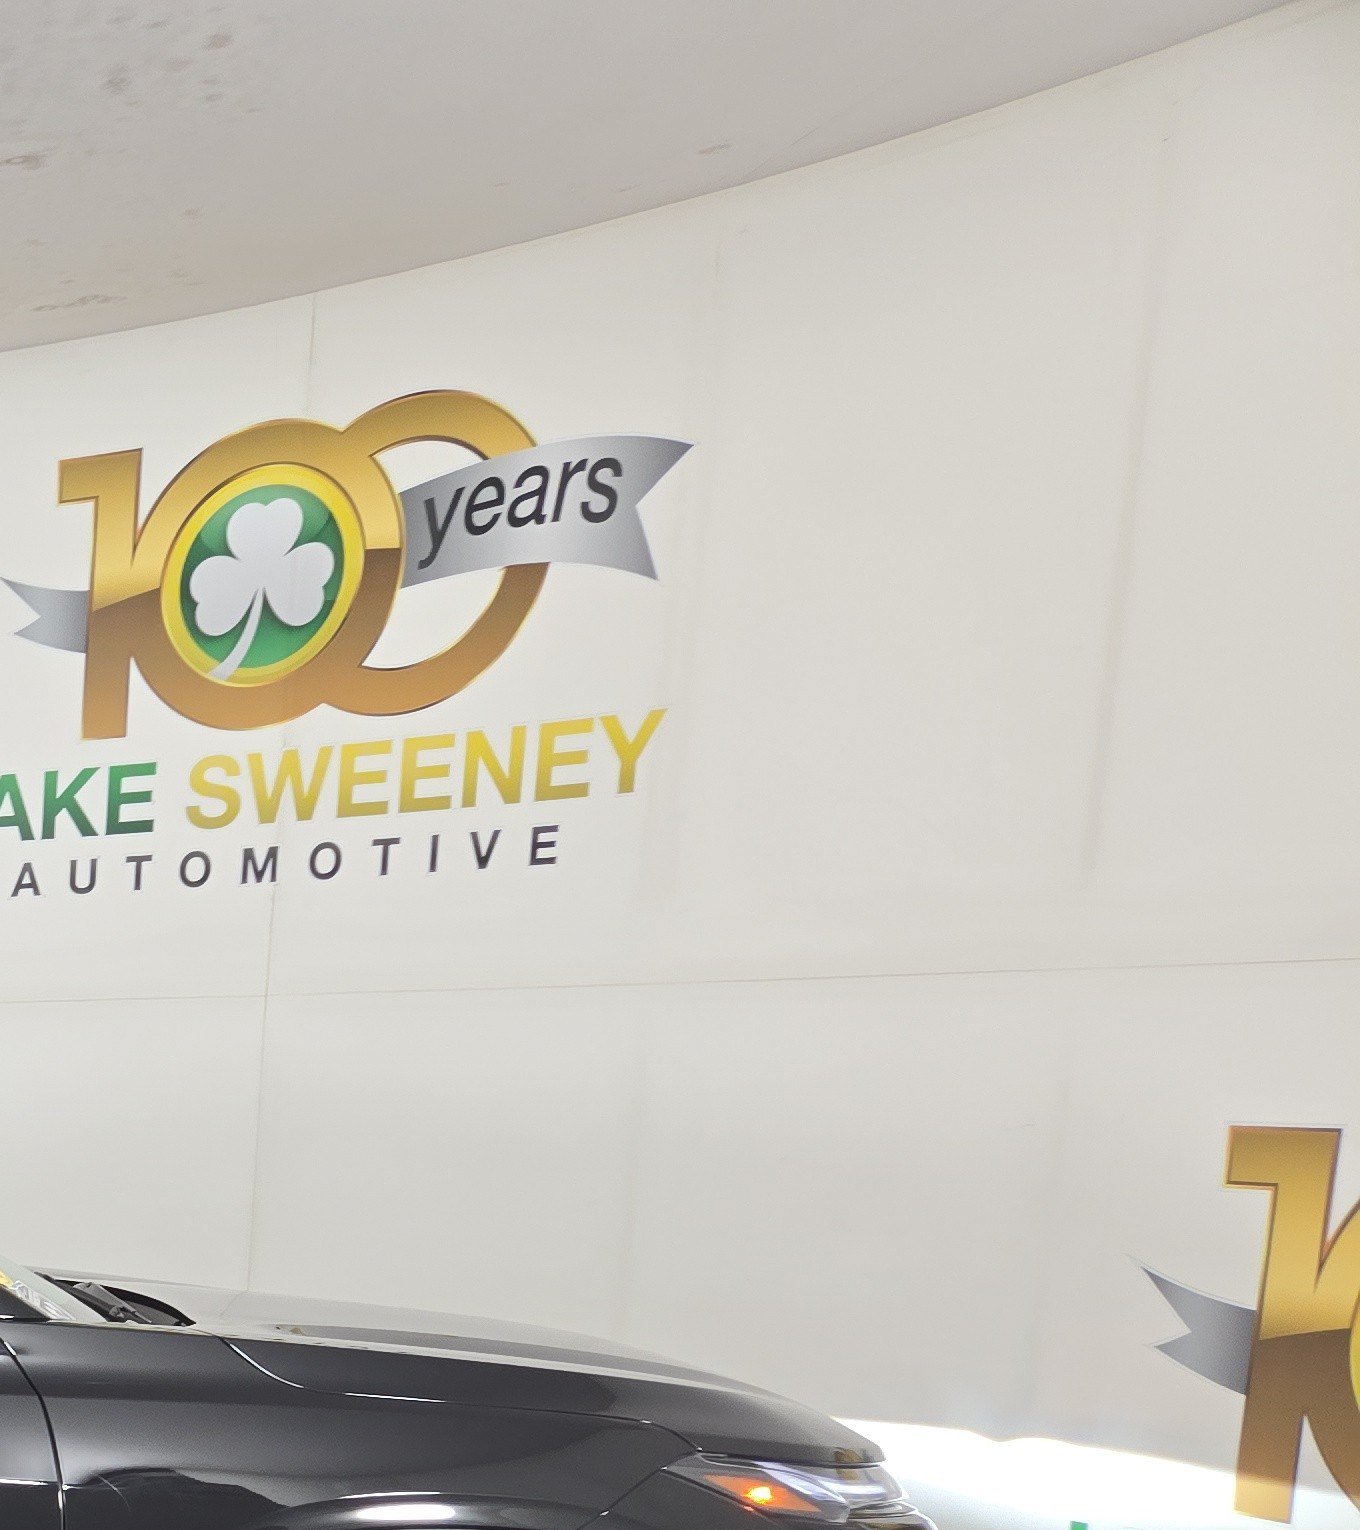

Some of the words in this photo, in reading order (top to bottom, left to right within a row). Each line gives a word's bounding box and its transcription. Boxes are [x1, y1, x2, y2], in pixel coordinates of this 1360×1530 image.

[417, 454, 624, 571] years
[185, 708, 669, 831] SWEENEY
[10, 823, 562, 900] AUTOMOTIVE
